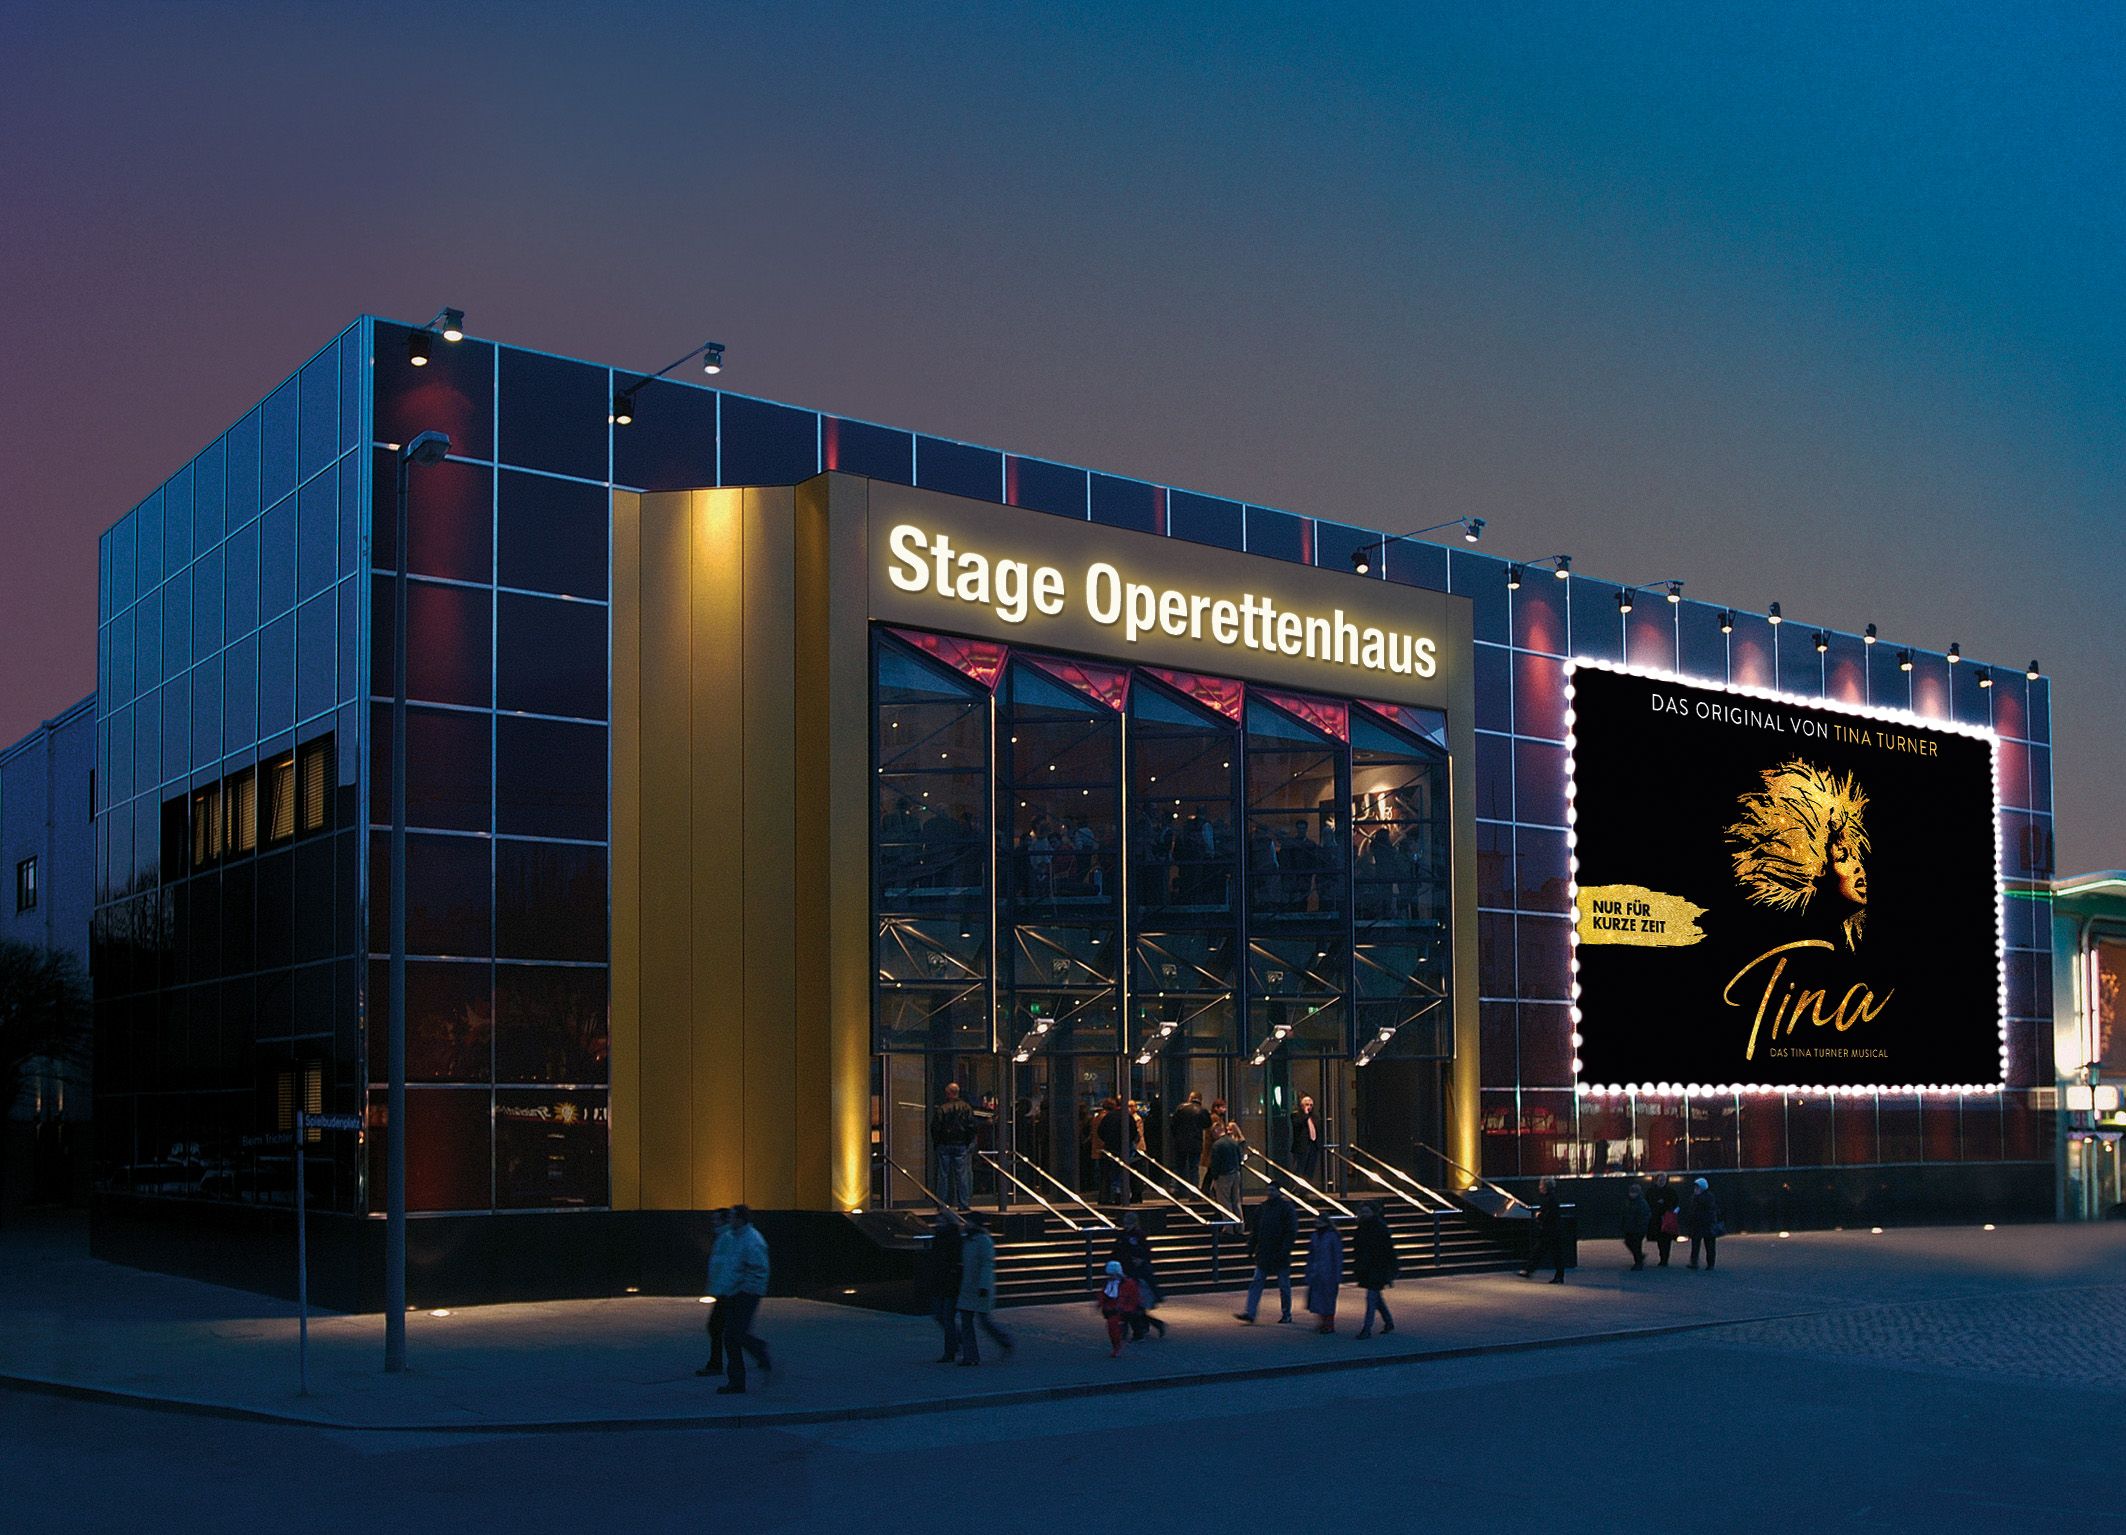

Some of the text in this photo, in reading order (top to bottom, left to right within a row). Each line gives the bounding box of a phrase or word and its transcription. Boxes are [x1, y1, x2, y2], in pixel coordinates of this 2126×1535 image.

[888, 524, 1438, 679] Stage Operettenhaus
[1651, 693, 1939, 758] DAS ORIGINAL VON TINA TURNER
[1592, 899, 1652, 917] NUR FÜR
[1592, 916, 1667, 934] KURZE ZEIT
[1722, 938, 1896, 1061] Tina
[1770, 1047, 1889, 1058] DAS TINA TURNER MUSICAL
